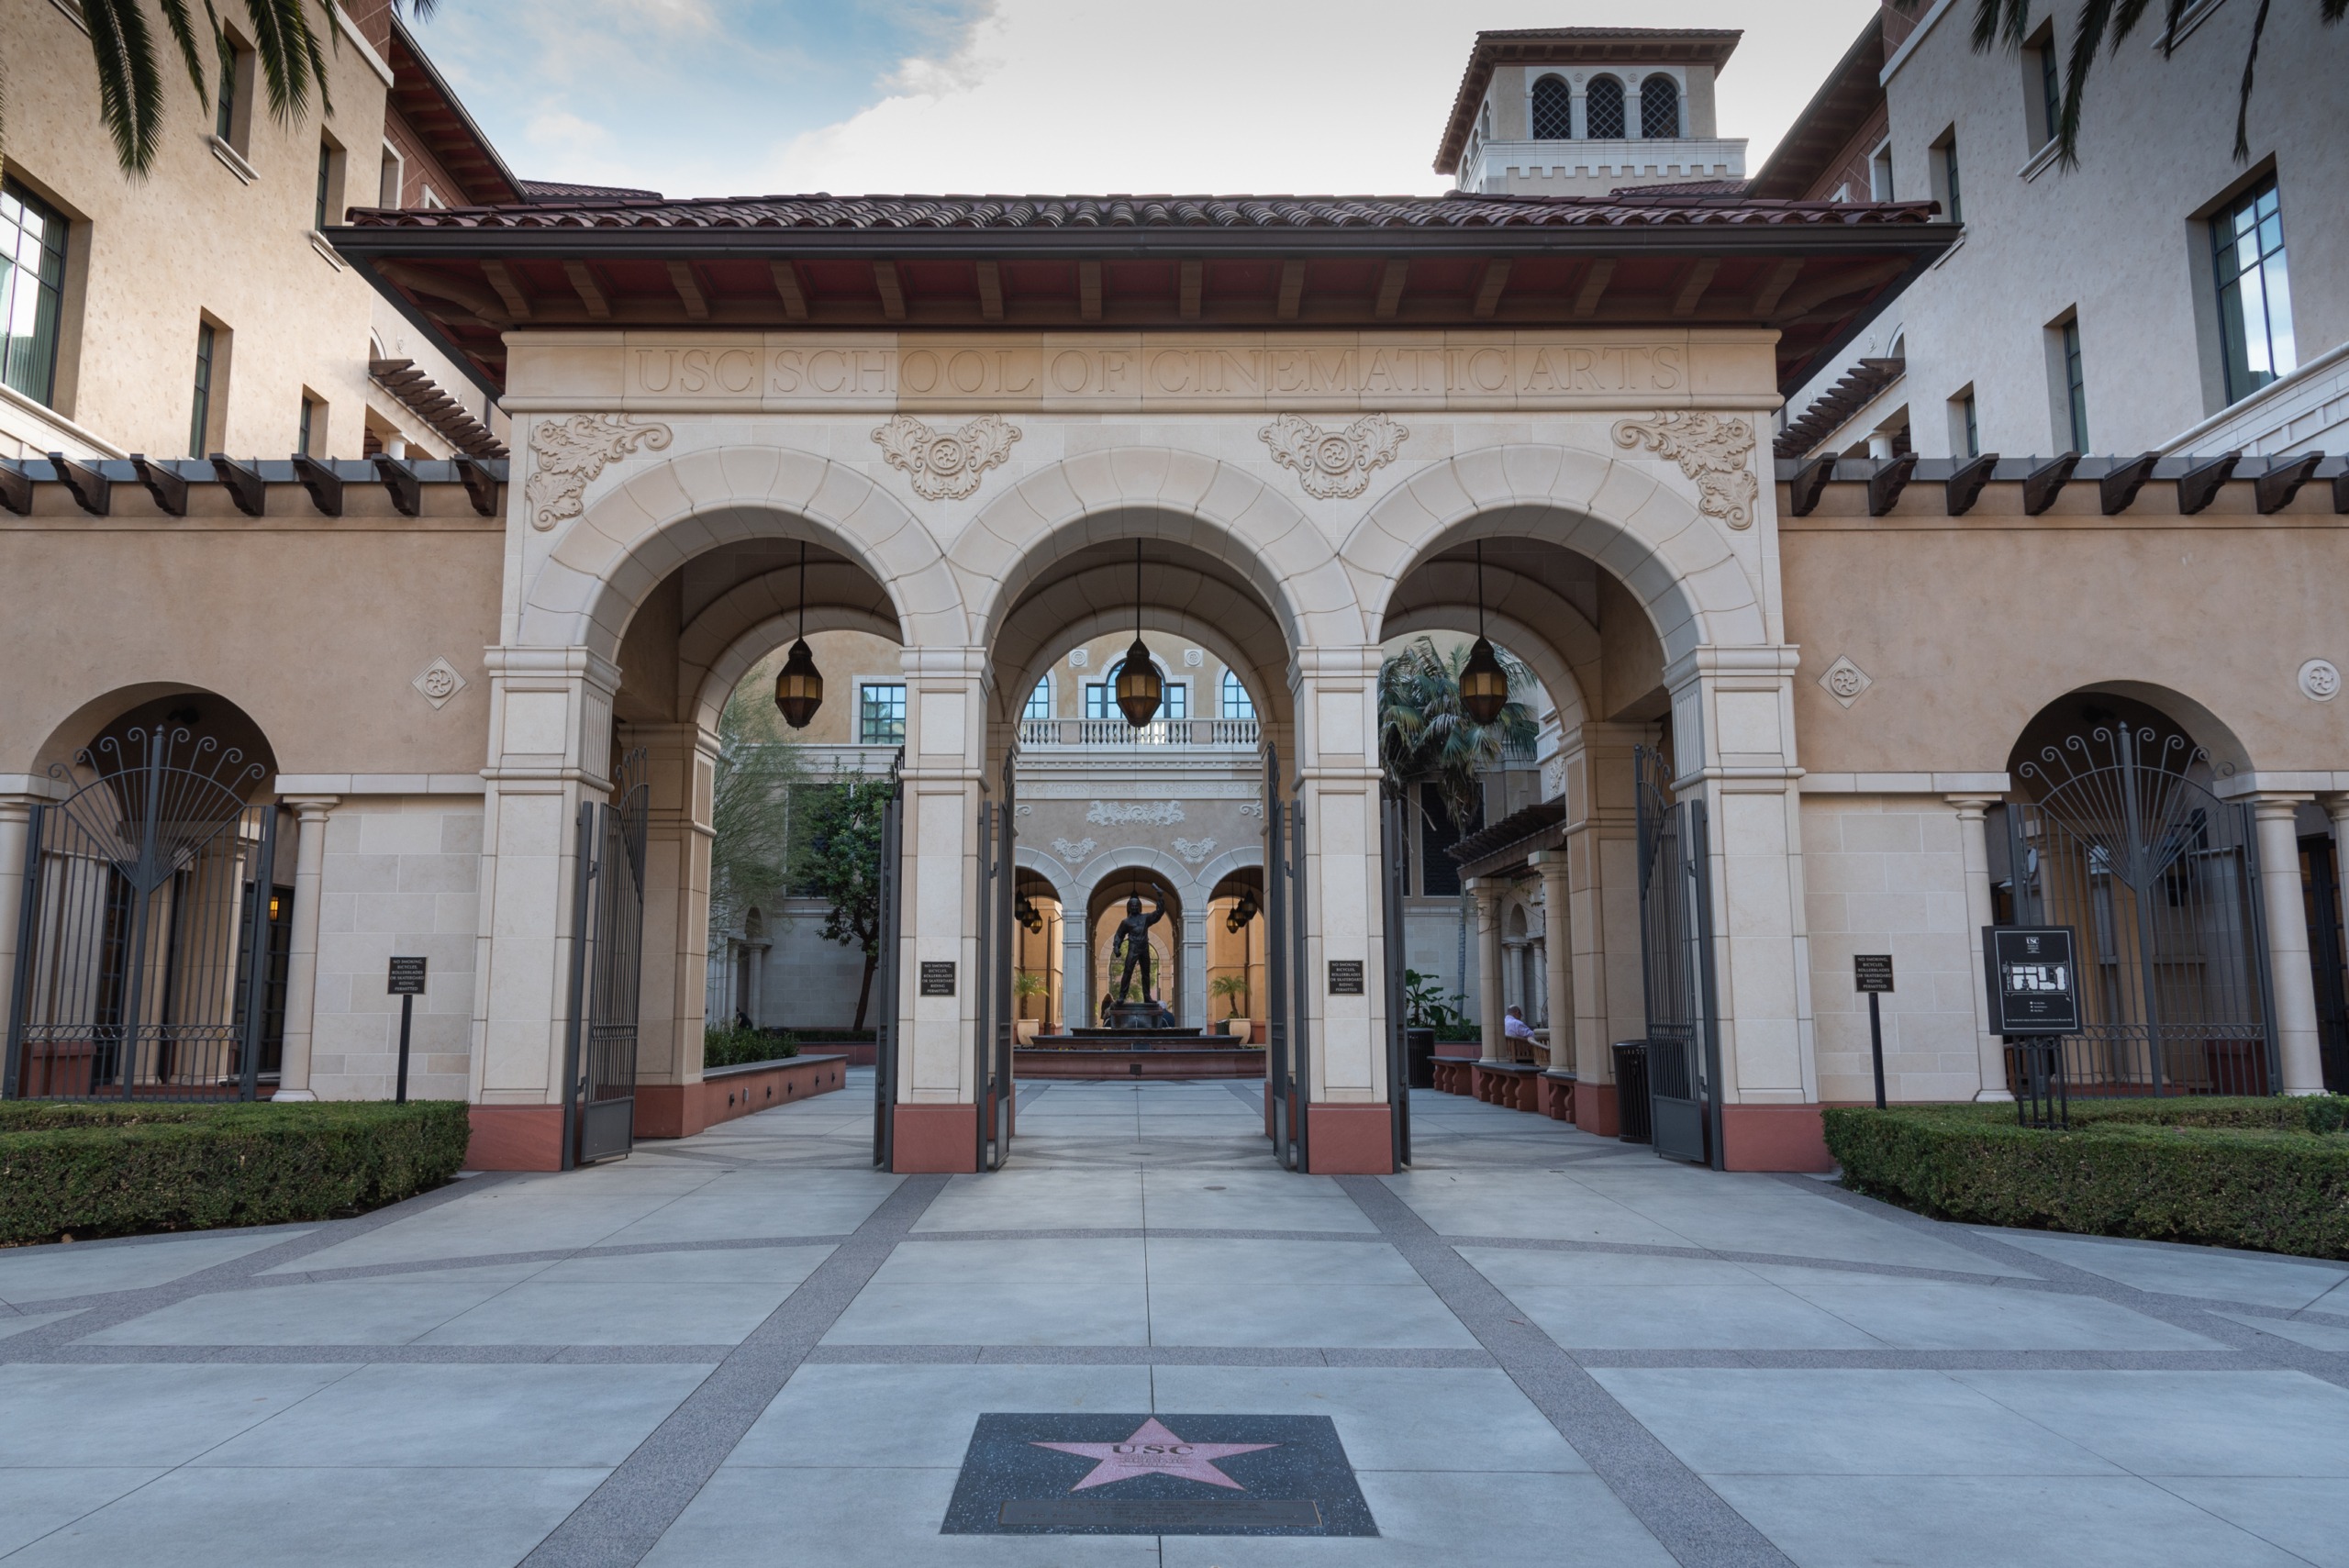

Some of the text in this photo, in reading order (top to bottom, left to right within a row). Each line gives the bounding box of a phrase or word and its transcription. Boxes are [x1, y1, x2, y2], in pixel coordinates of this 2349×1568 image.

[635, 345, 1684, 394] USC SCHOOL OF CINEMATIC ARTS
[1046, 784, 1089, 794] MOTION
[1091, 784, 1136, 794] PICTURE
[1137, 784, 1163, 794] ARTS
[1164, 784, 1174, 793] &
[1174, 784, 1225, 794] SCIENCES
[1112, 1445, 1194, 1454] USC
